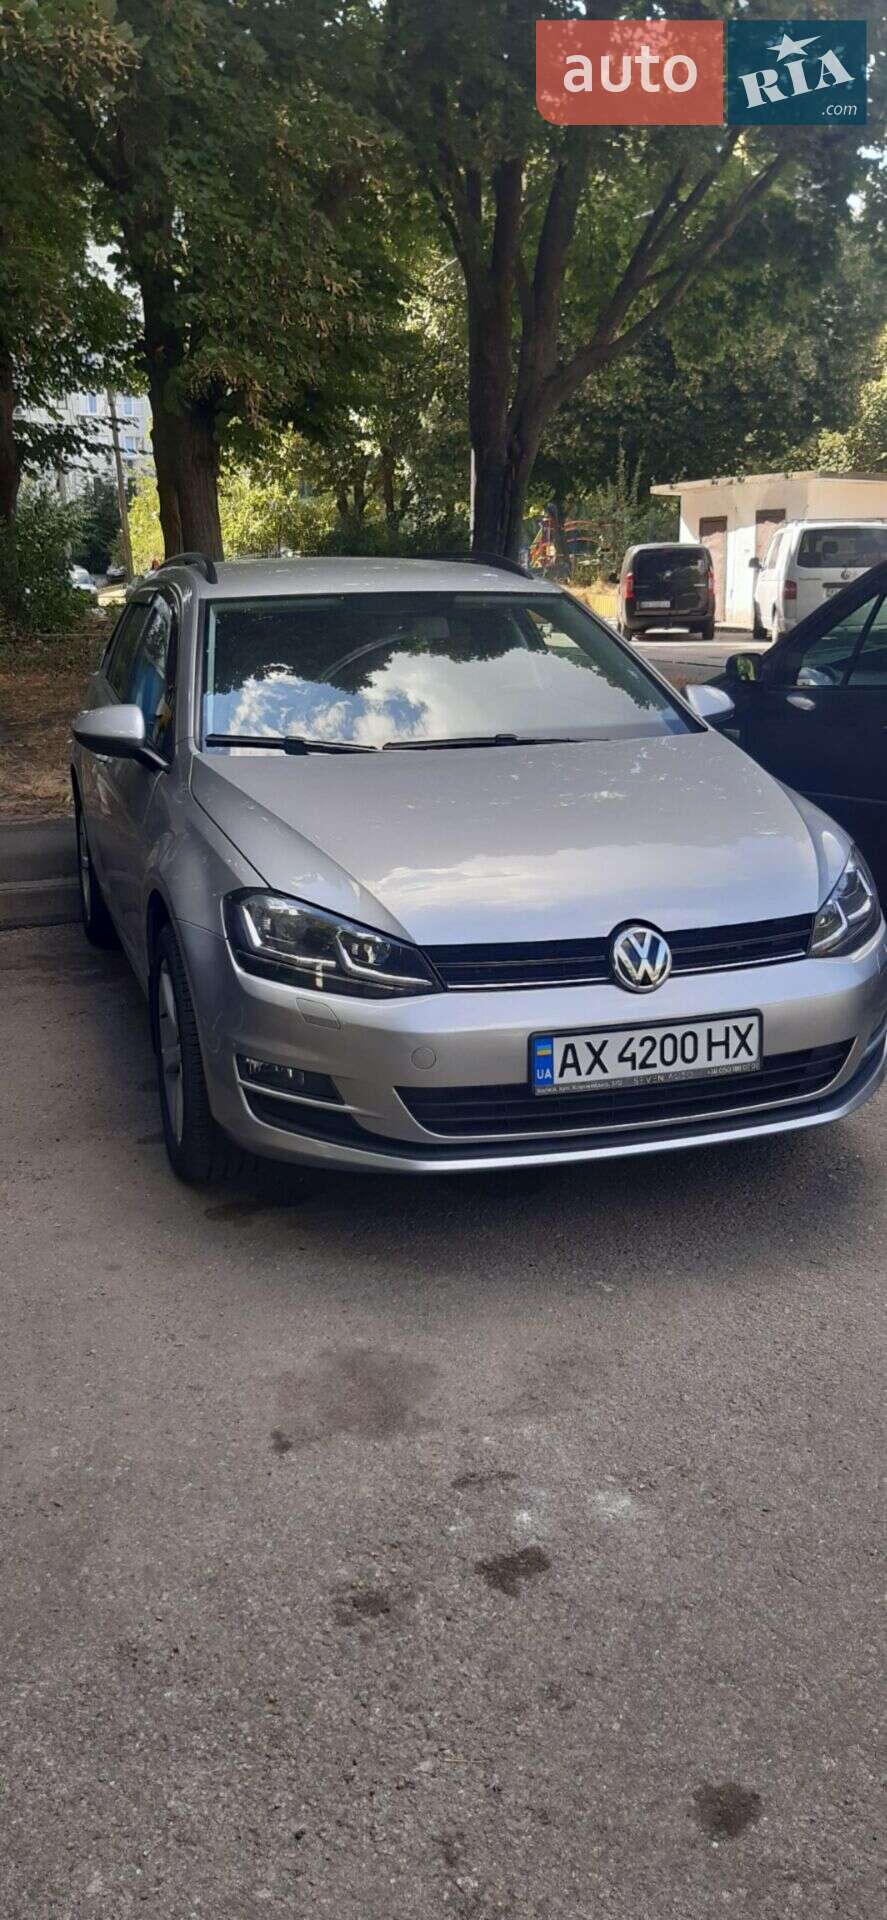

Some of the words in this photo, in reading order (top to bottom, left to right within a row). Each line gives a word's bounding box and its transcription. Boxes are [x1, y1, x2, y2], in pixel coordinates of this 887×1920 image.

[558, 1039, 609, 1078] AX
[618, 1031, 698, 1071] 4200
[707, 1023, 754, 1062] HX
[536, 1068, 552, 1080] UA
